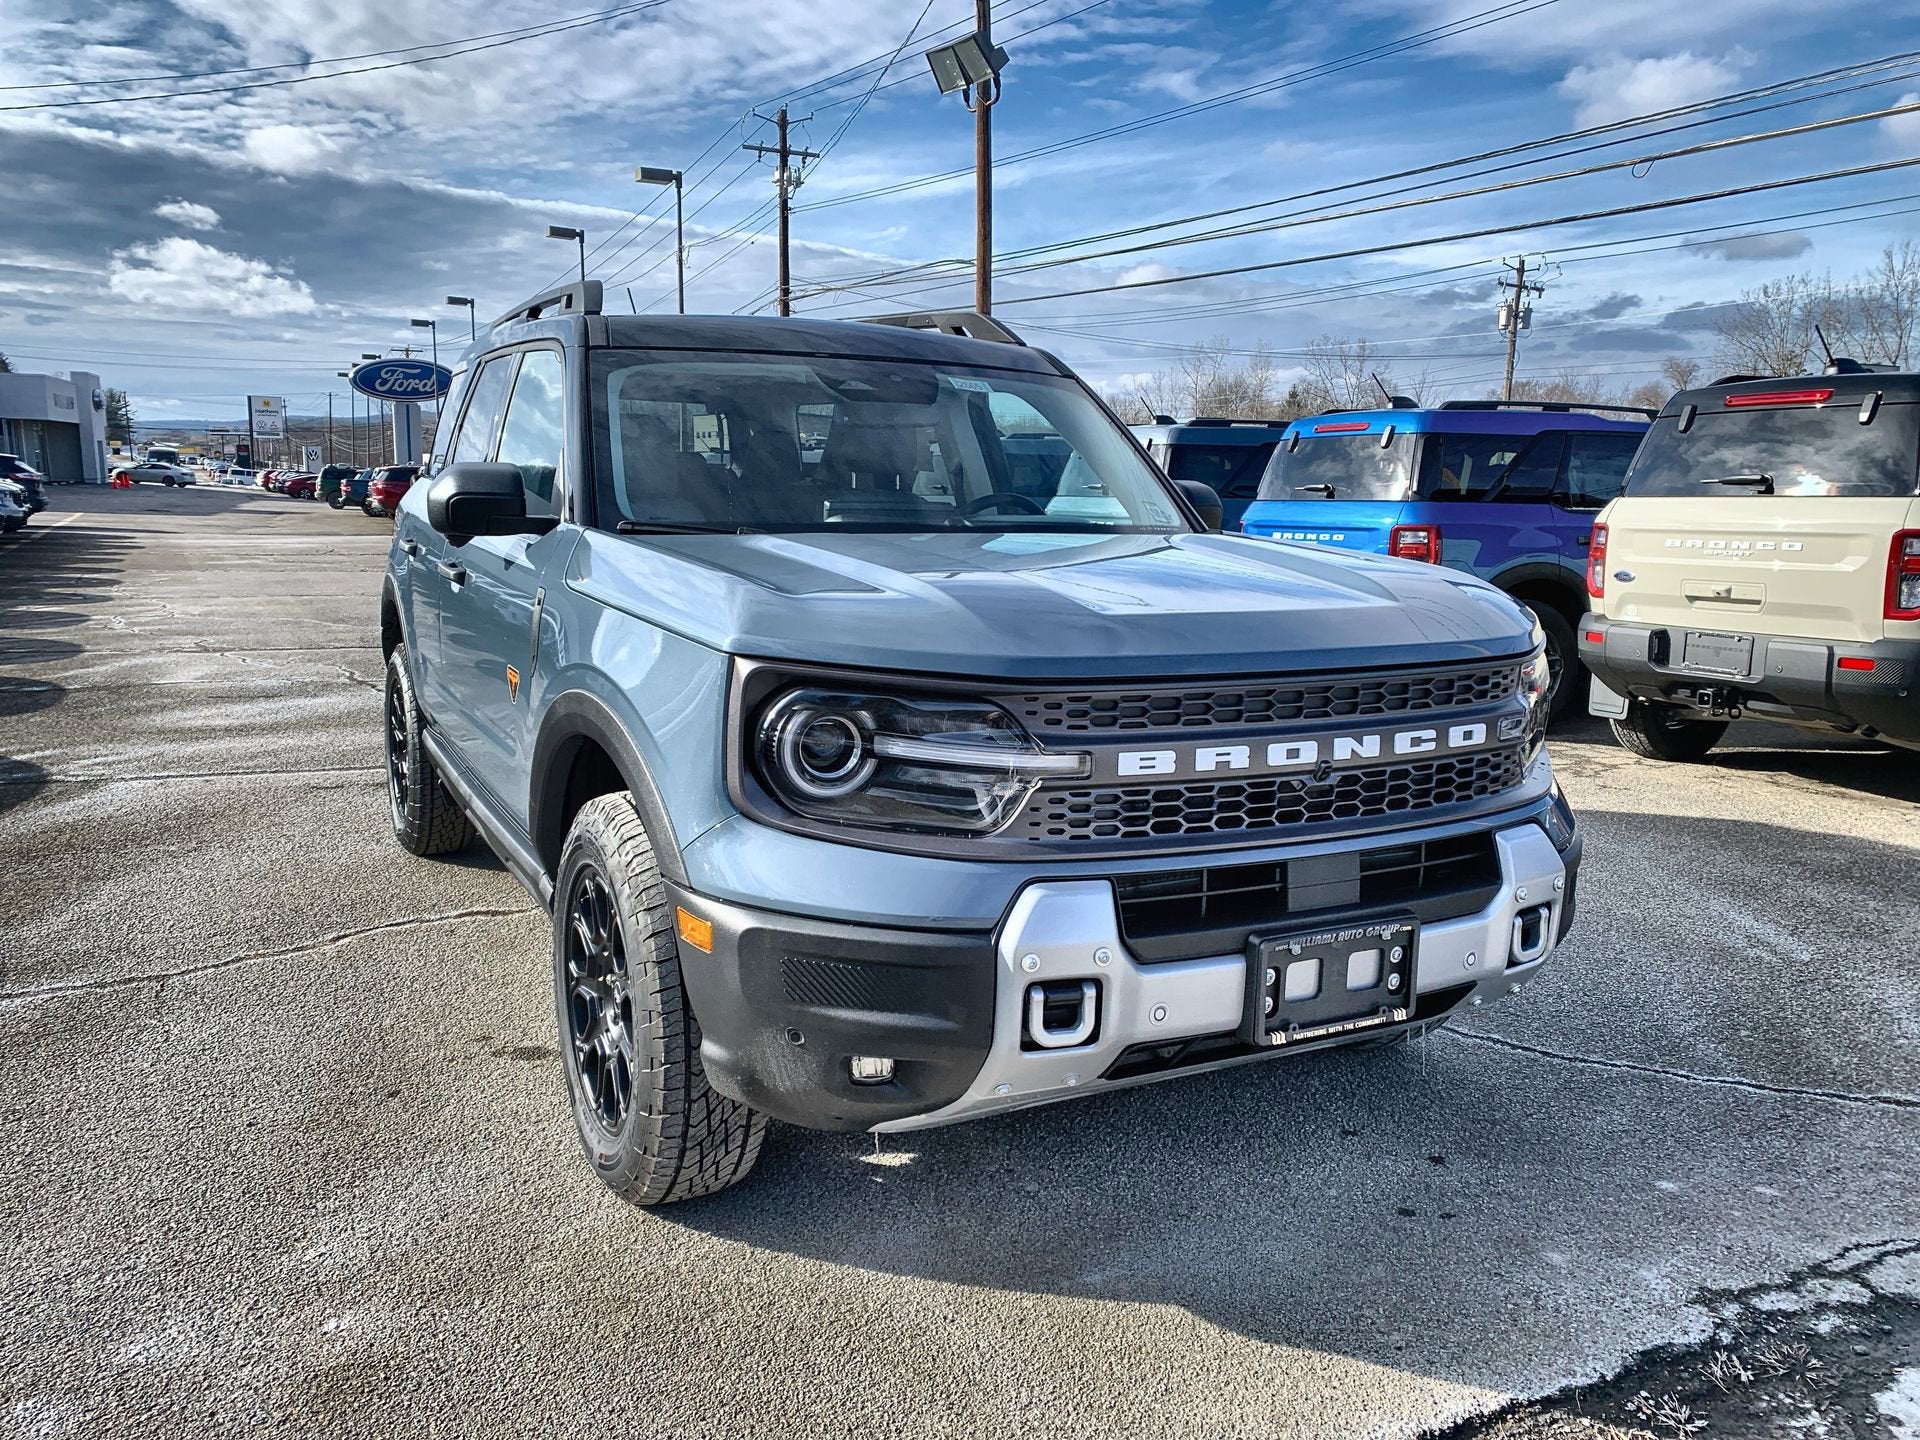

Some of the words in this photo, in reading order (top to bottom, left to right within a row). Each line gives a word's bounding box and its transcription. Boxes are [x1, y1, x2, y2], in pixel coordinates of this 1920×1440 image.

[375, 366, 437, 392] Ford
[1272, 532, 1345, 541] BRONCO
[1664, 538, 1803, 551] BRONCO
[1117, 722, 1487, 777] BRONCO
[1337, 929, 1364, 942] AUTO
[1293, 1028, 1327, 1041] PARTNERING
[1328, 1026, 1343, 1034] WITH
[1344, 1023, 1355, 1031] THE
[1355, 1017, 1387, 1029] COMMUNITY
